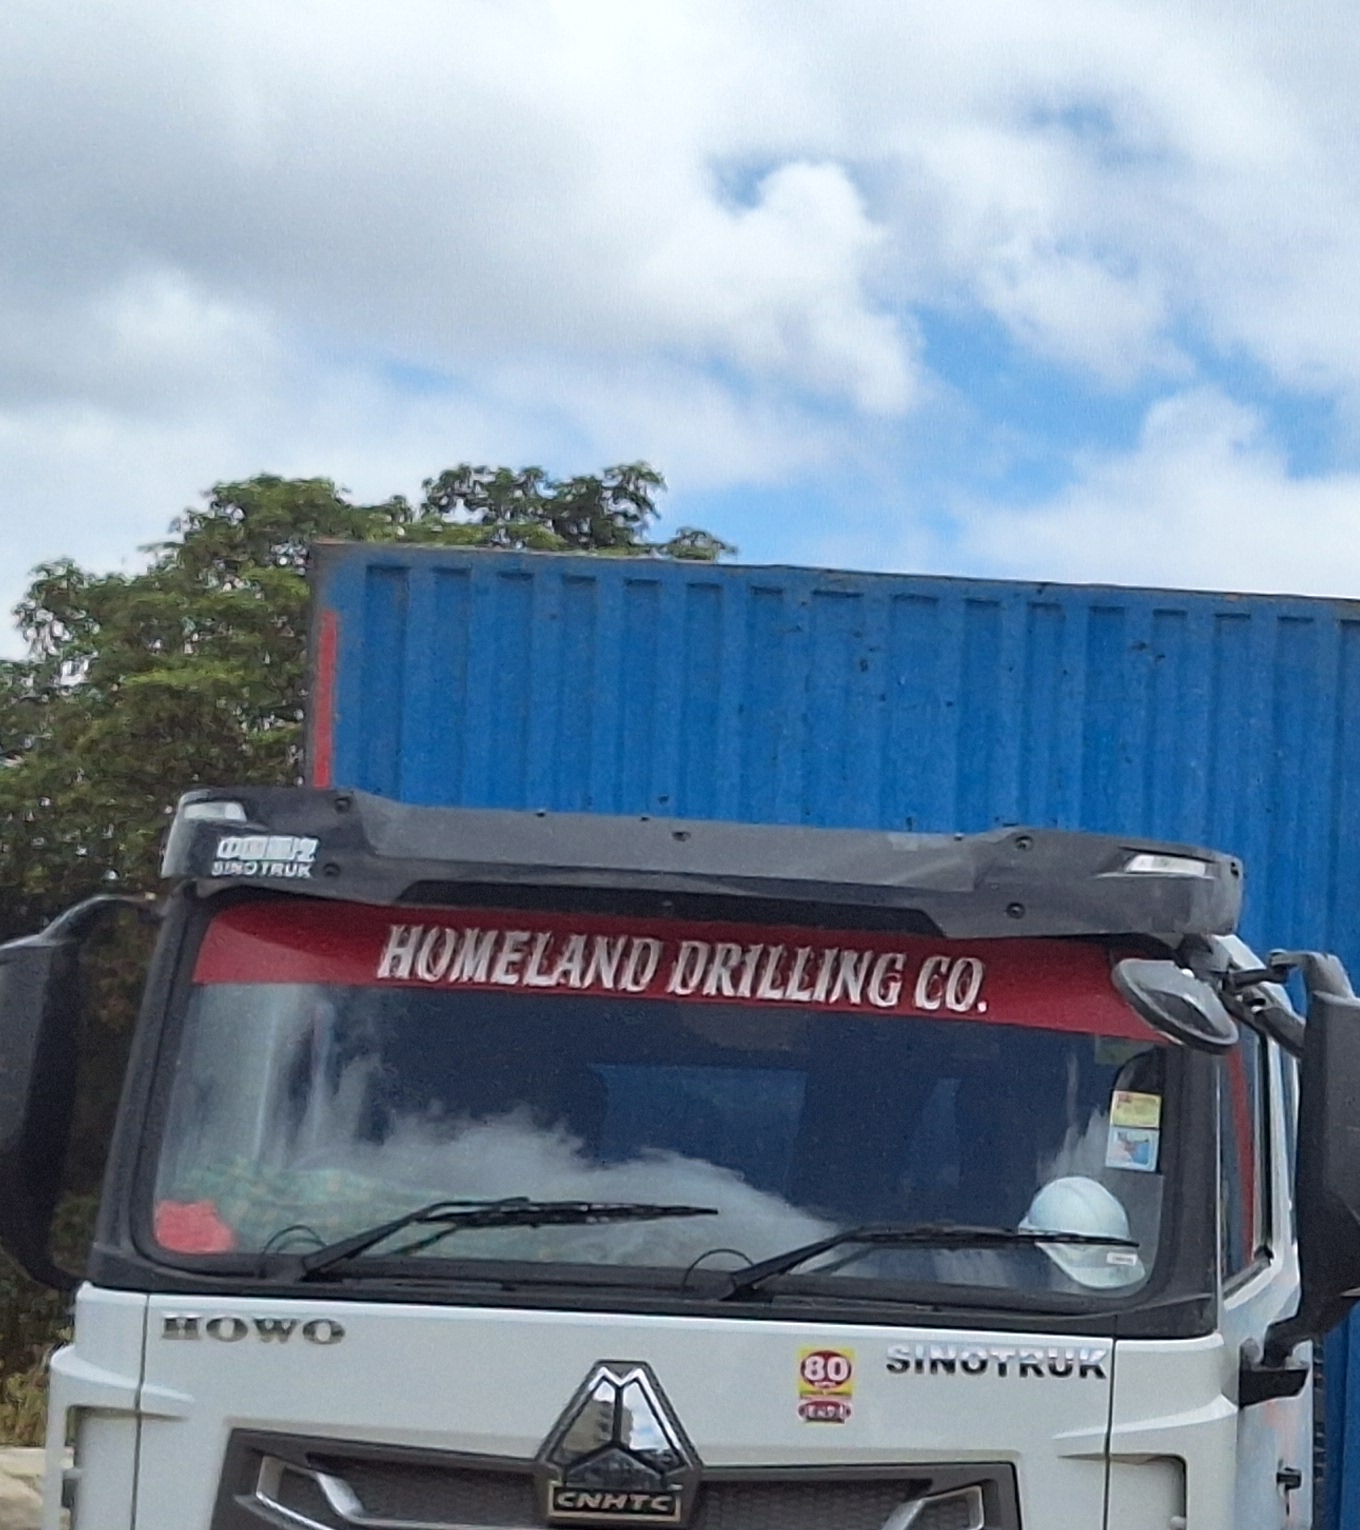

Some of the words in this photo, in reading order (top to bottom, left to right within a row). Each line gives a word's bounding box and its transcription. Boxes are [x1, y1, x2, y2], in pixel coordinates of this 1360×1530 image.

[211, 860, 312, 879] SINOTRUK
[377, 924, 664, 995] HOMELAND
[666, 941, 906, 1008] DRILLING
[914, 955, 987, 1013] CO.
[162, 1313, 346, 1345] HOWO
[804, 1356, 849, 1381] 80
[886, 1345, 1107, 1379] SINOTRUK
[557, 1491, 673, 1512] CNHTC
